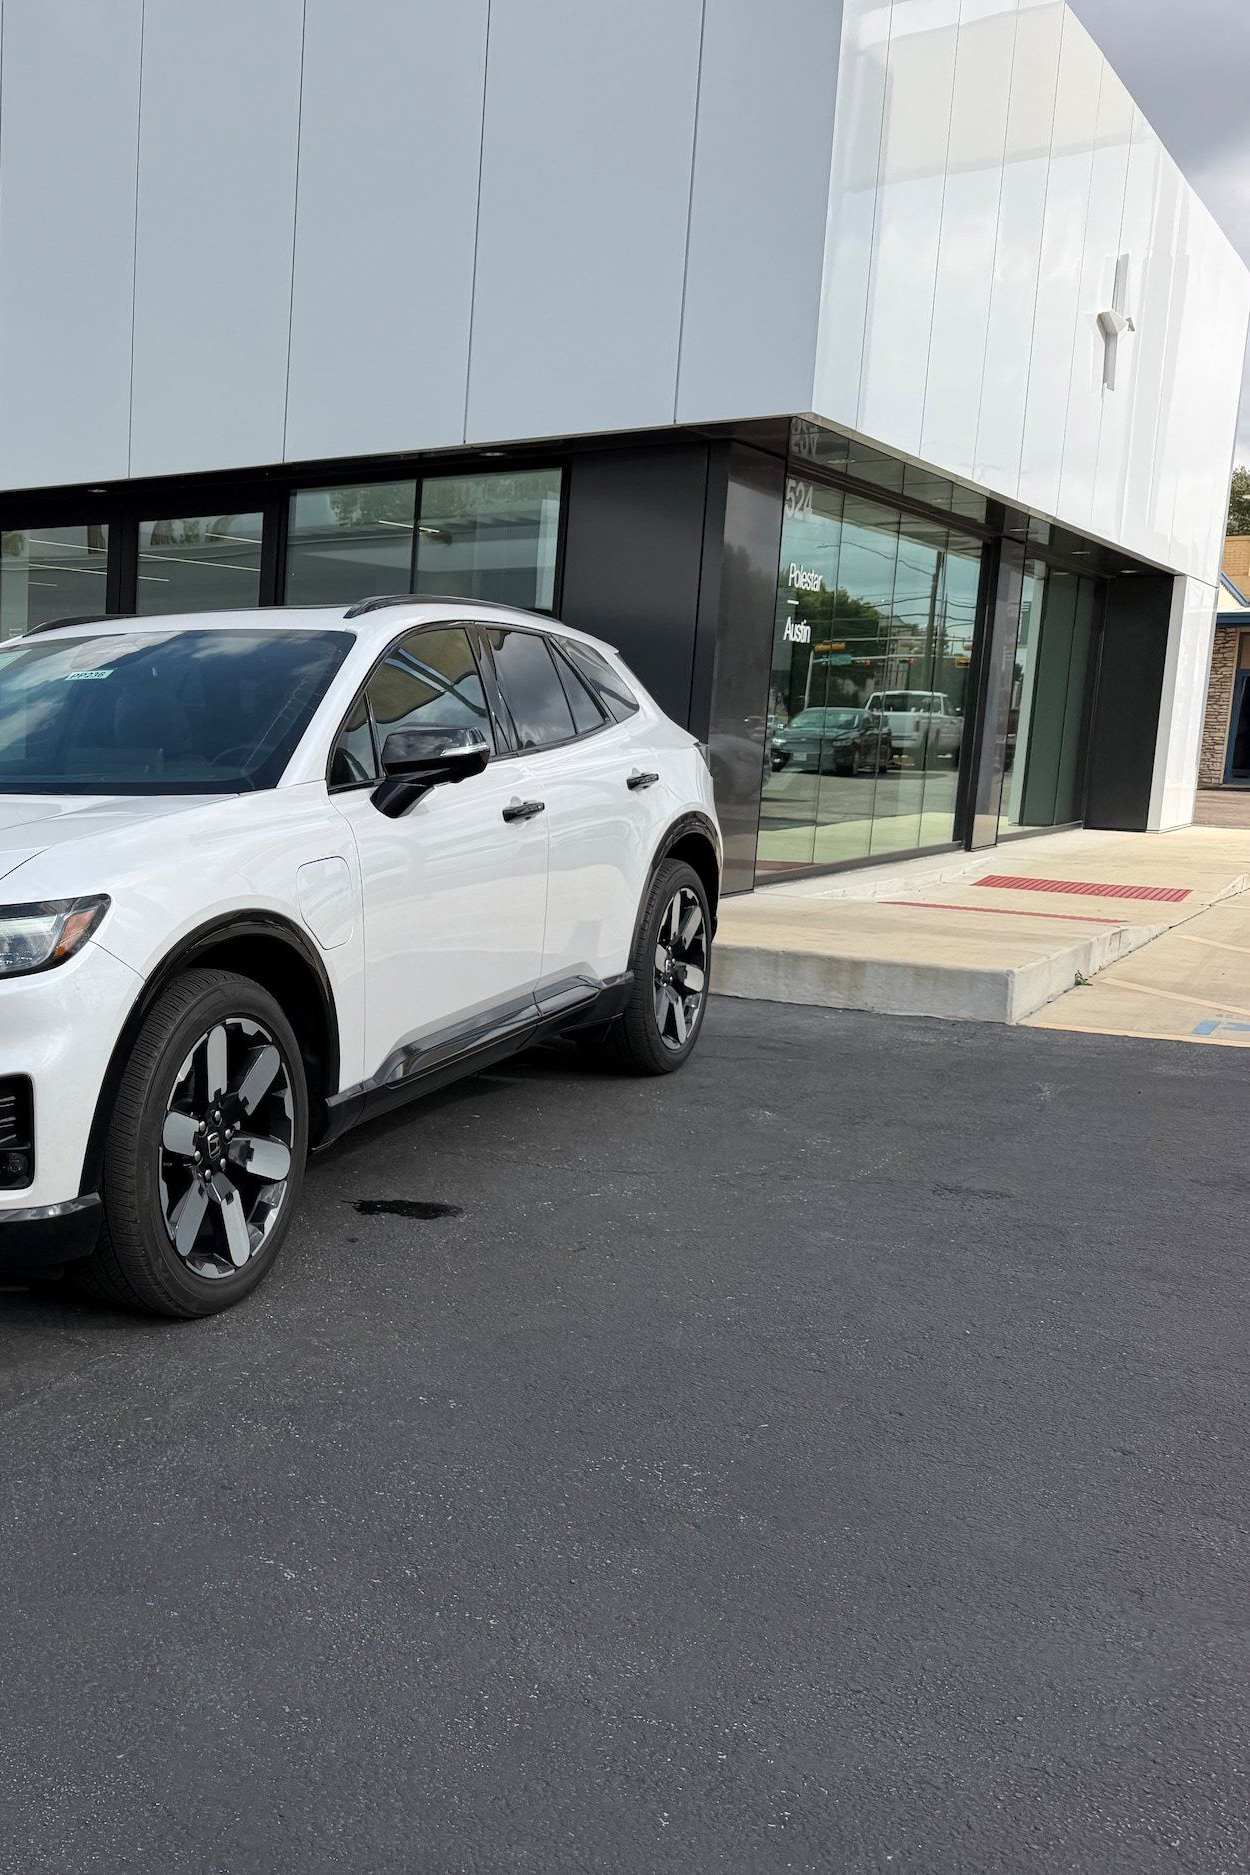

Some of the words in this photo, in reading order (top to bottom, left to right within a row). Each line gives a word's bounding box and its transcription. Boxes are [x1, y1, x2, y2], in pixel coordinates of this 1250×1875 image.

[784, 478, 813, 520] 524
[789, 562, 822, 592] Polestar
[783, 616, 811, 644] Austin
